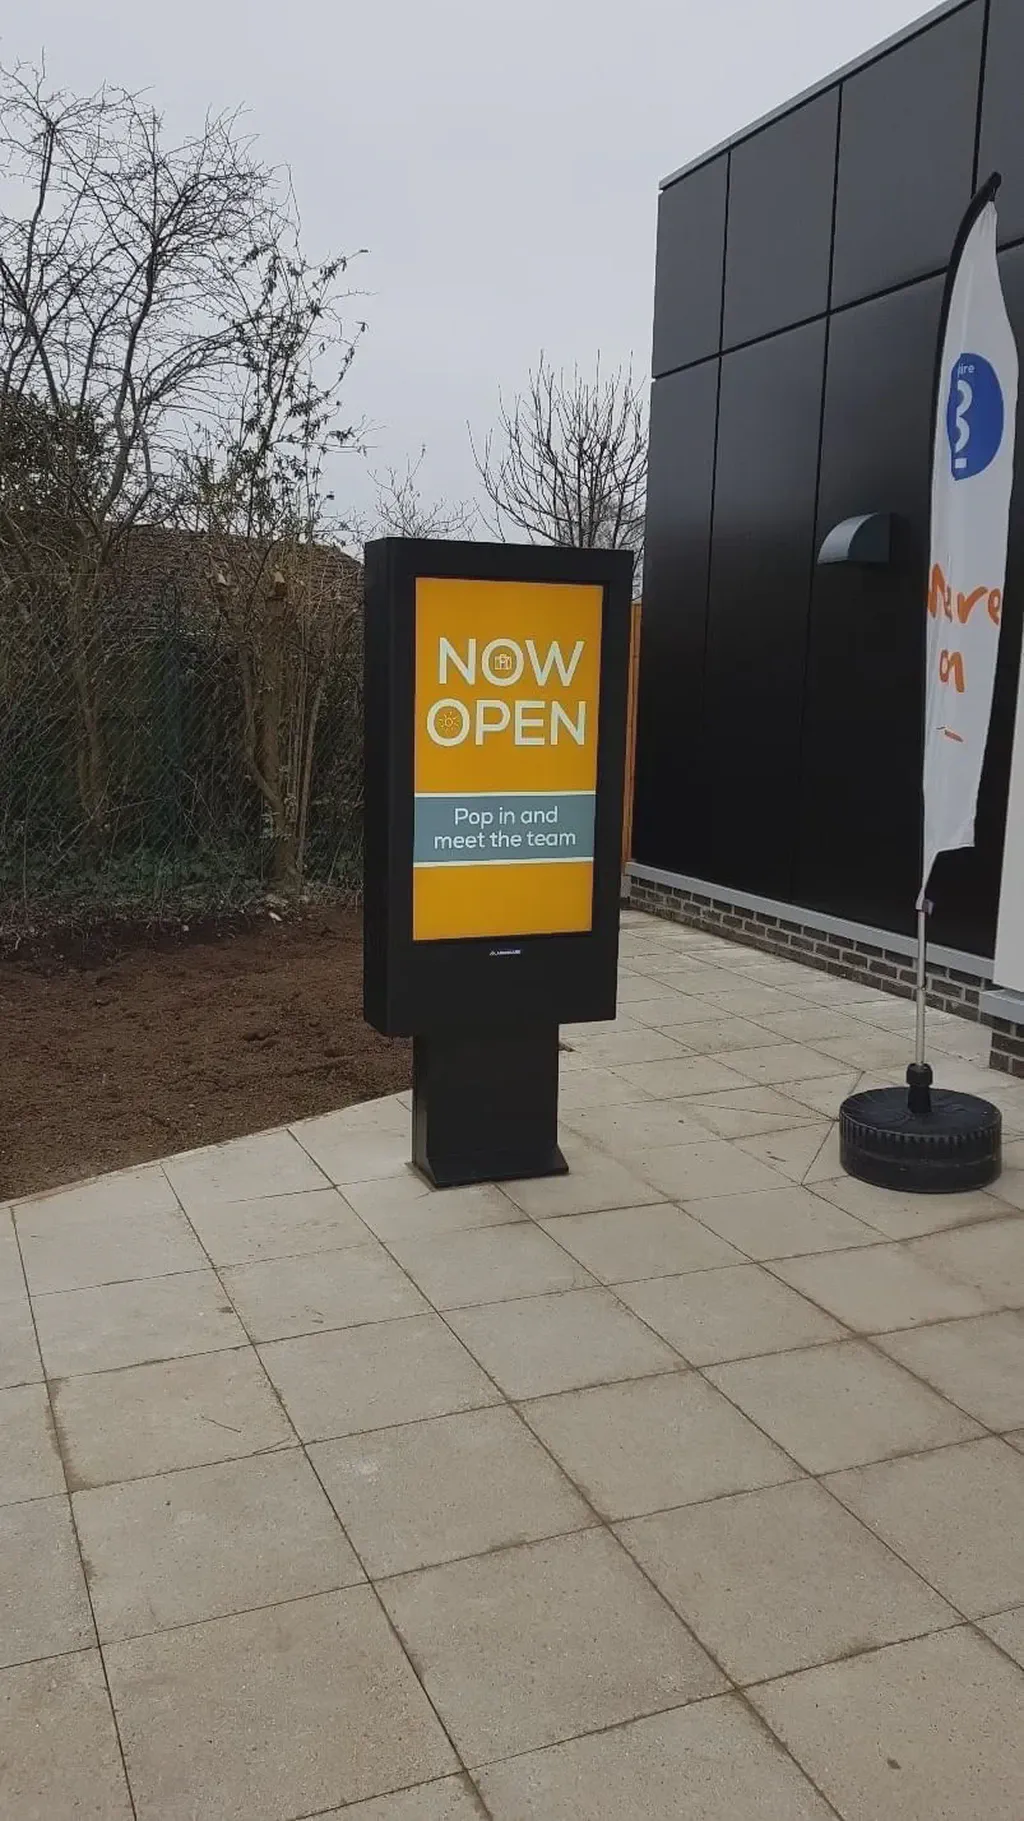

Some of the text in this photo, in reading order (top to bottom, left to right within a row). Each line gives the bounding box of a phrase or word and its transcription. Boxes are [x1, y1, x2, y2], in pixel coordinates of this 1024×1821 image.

[438, 636, 585, 687] NOW
[426, 698, 587, 747] OPEN
[454, 805, 559, 829] Pop in and
[433, 830, 577, 850] meet the team
